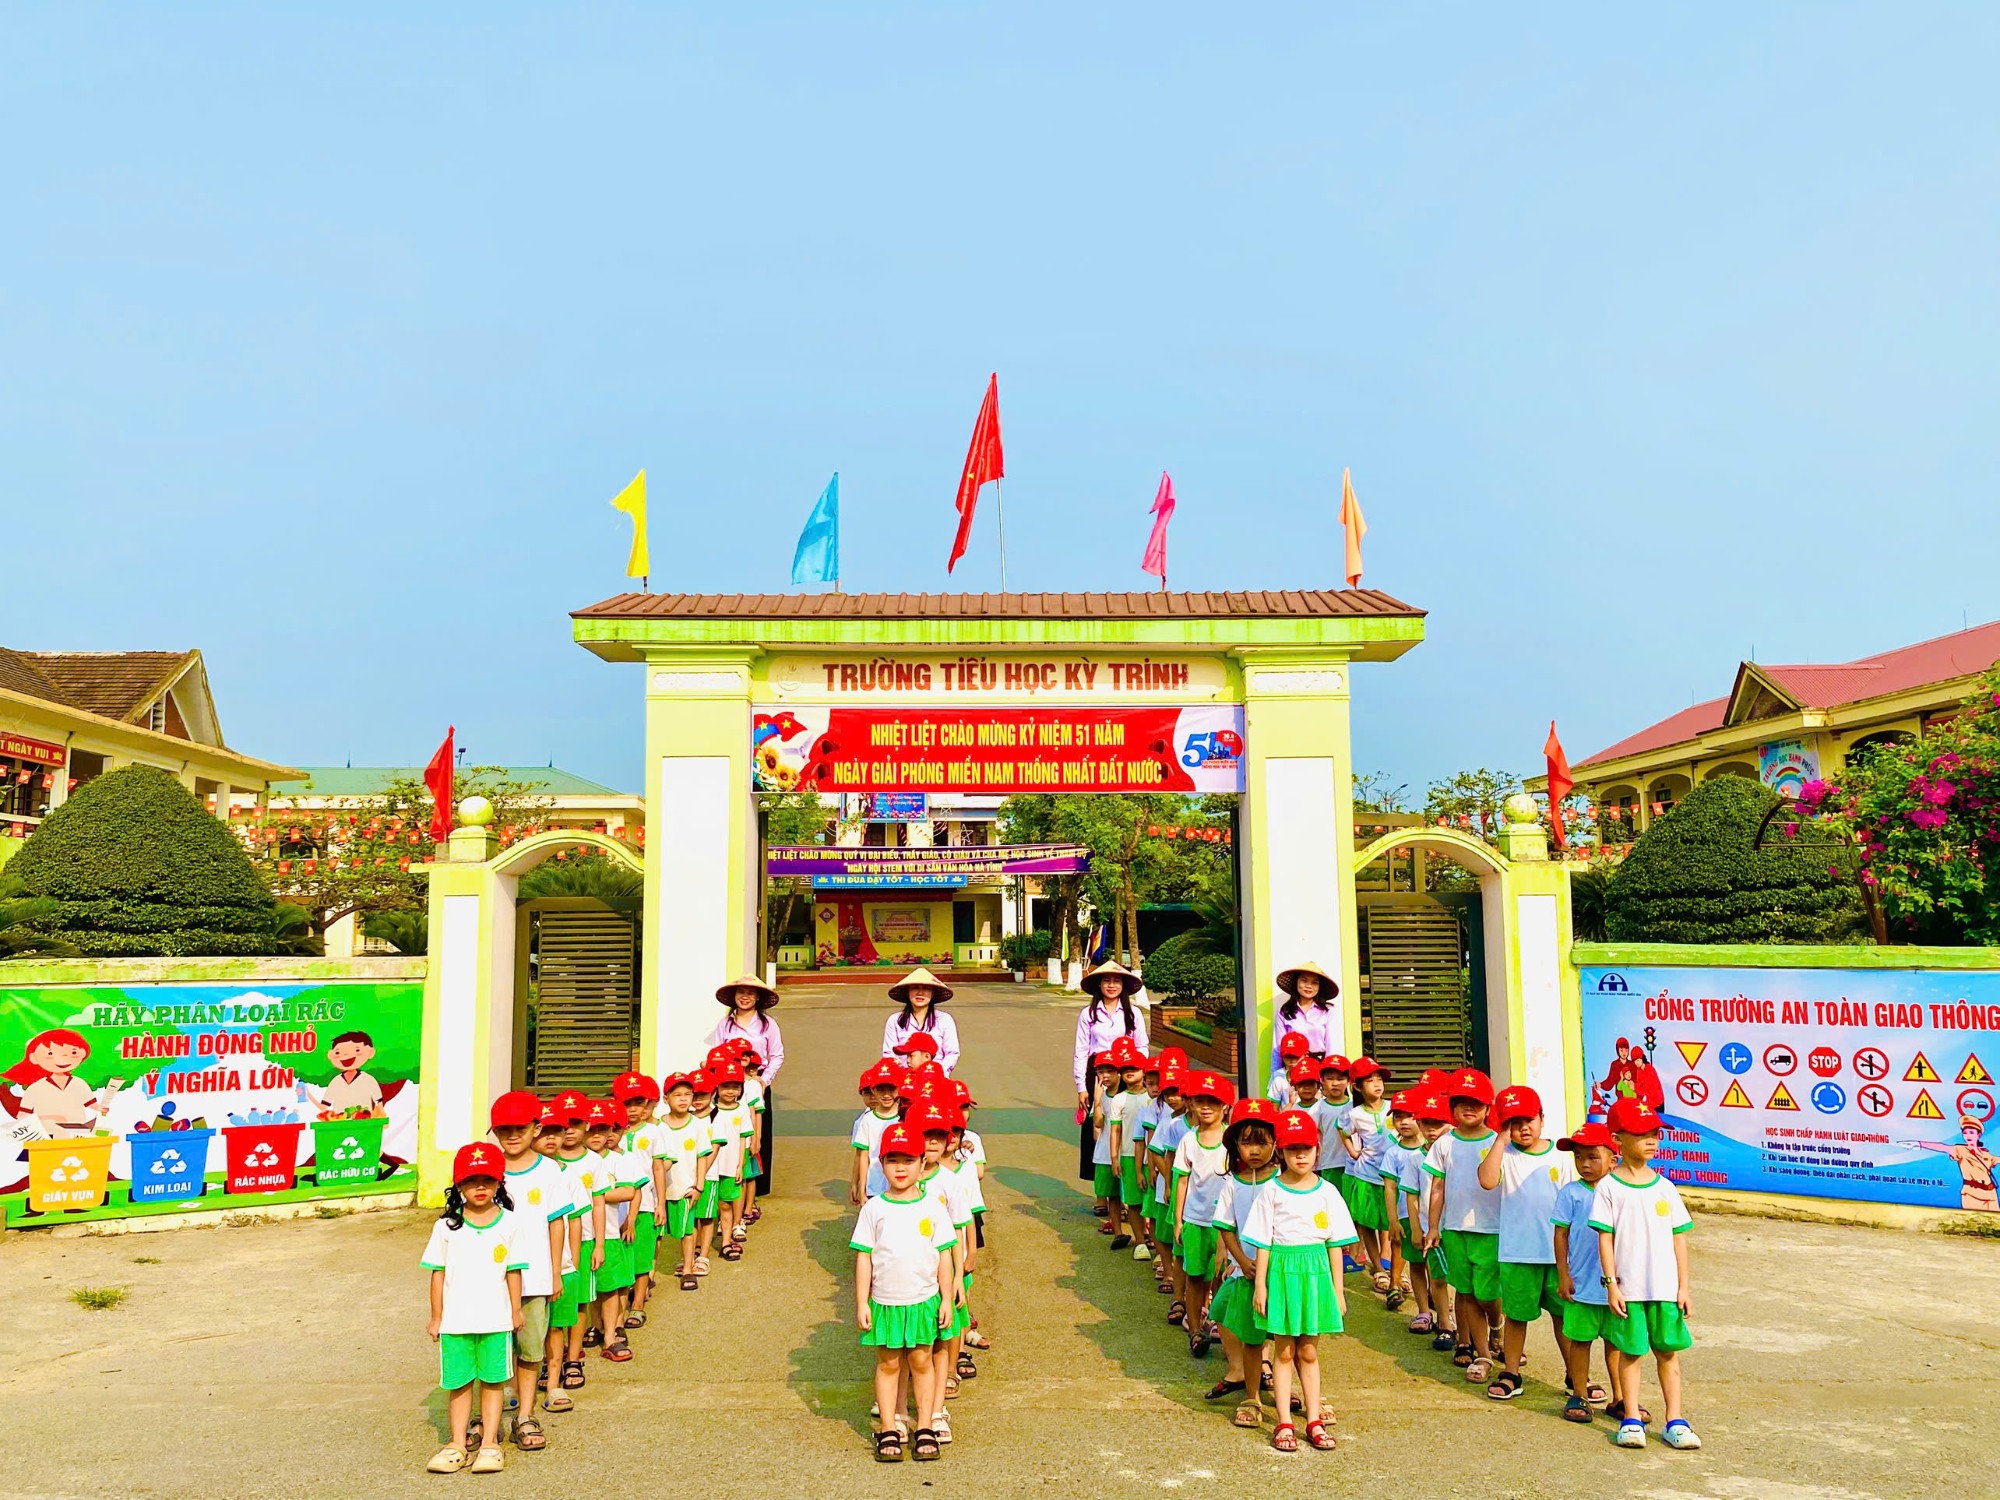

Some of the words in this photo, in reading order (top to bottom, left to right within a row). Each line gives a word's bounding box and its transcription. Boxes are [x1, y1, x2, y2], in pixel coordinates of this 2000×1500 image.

[822, 656, 931, 691] TRƯỜNG
[939, 656, 997, 691] TIỂU
[1004, 663, 1057, 695] HỌC
[1064, 656, 1098, 690] KỲ
[871, 719, 908, 751] NHIỆT
[911, 719, 937, 751] LIỆT
[940, 719, 974, 746] CHÀO
[977, 719, 1016, 746] MỪNG
[1019, 716, 1035, 746] KỶ
[1039, 719, 1072, 751] NIỆM
[1075, 723, 1090, 746] 51
[1094, 719, 1124, 746] NĂM
[7, 740, 32, 756] NGÀY
[34, 747, 49, 759] VUI
[834, 757, 868, 784] NGÀY
[871, 755, 897, 784] GIẢI
[900, 757, 944, 784] PHÓNG
[984, 761, 1013, 784] NAM
[1017, 754, 1059, 784] THỐNG
[1062, 754, 1096, 784] NHẤT
[1099, 754, 1123, 784] ĐẤT
[1126, 757, 1163, 784] NƯỚC
[783, 849, 797, 861] LIỆT
[882, 863, 903, 873] STEM
[910, 876, 928, 885] HỌC
[93, 1003, 147, 1026] HÃY
[154, 1002, 226, 1024] PHÂN
[232, 1003, 291, 1027] LOẠI
[298, 999, 346, 1021] RÁC
[1645, 989, 1695, 1021] CỔNG
[1699, 994, 1775, 1024] TRƯỜNG
[1781, 1001, 1809, 1025] AN
[1814, 997, 1868, 1026] TOÀN
[1874, 1002, 1923, 1028] GIAO
[1929, 999, 2000, 1031] THÔNG
[122, 1032, 190, 1058] HÀNH
[198, 1030, 262, 1060] ĐỘNG
[270, 1024, 317, 1054] NHỎ
[1811, 1055, 1839, 1069] STOP
[146, 1069, 160, 1095] Ý
[168, 1067, 241, 1094] NGHĨA
[249, 1065, 294, 1090] LỚN
[1667, 1129, 1700, 1143] THÔNG
[1765, 1127, 1778, 1137] HỌC
[1779, 1128, 1795, 1137] SINH
[1761, 1141, 1767, 1149] 1.
[1682, 1148, 1710, 1163] HÀNH
[235, 1175, 255, 1187] RÁC
[258, 1173, 286, 1186] NHỰA
[319, 1169, 339, 1181] RÁC
[341, 1166, 360, 1177] HỮU
[362, 1166, 376, 1176] CƠ
[1668, 1167, 1691, 1181] GIAO
[1695, 1169, 1728, 1184] THÔNG
[143, 1184, 165, 1195] KIM
[167, 1181, 191, 1194] LOẠI
[42, 1189, 68, 1203] GIẤY
[71, 1190, 95, 1202] VỤN
